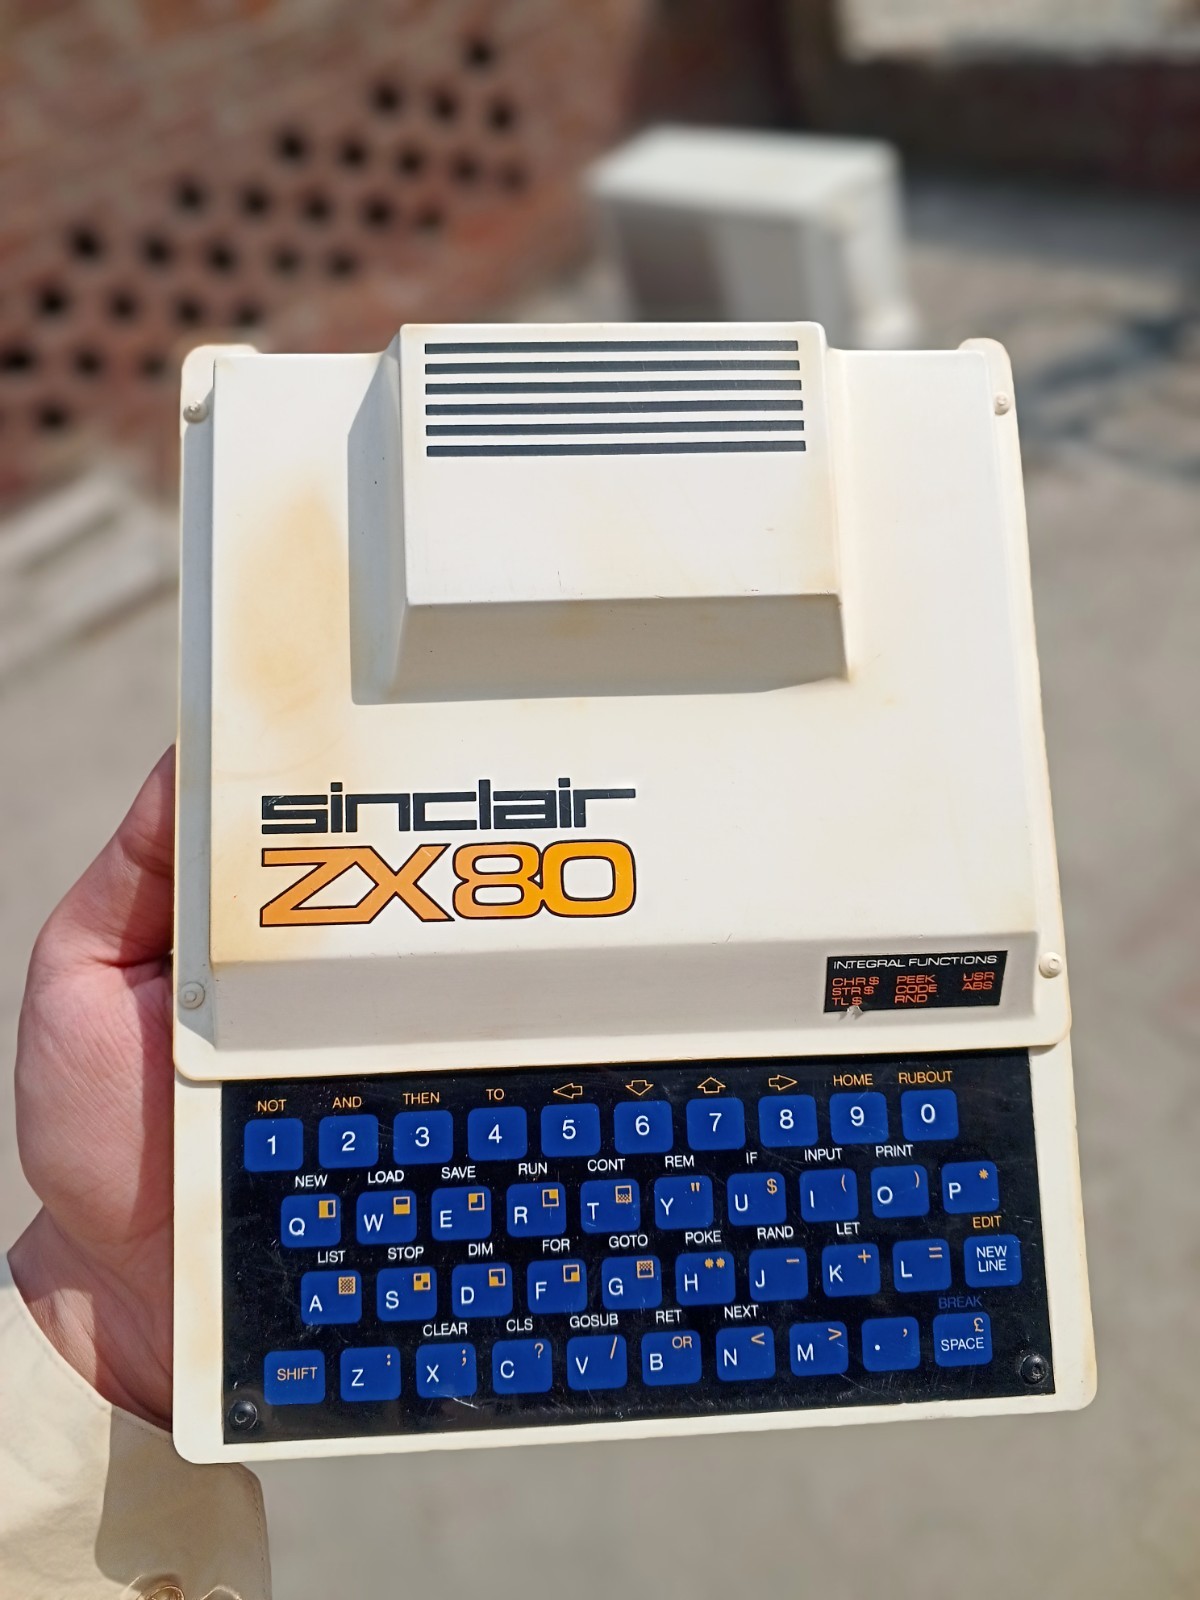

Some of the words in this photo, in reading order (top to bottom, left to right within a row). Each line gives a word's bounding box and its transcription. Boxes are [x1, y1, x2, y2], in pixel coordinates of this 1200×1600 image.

[261, 777, 636, 835] sinclair
[259, 838, 637, 928] ZX80
[833, 958, 906, 969] INTEGRAL
[908, 955, 998, 967] FUNCTIONS
[896, 974, 936, 983] PEEK
[963, 971, 995, 981] USR
[895, 984, 938, 994] CODE
[962, 981, 993, 991] ABS
[894, 994, 928, 1004] RND
[833, 1073, 874, 1087] HOME
[898, 1070, 953, 1084] RUBOUT
[332, 1095, 362, 1109] AND
[402, 1091, 440, 1105] THEN
[485, 1088, 505, 1101] TO
[257, 1098, 287, 1112] NOT
[779, 1108, 794, 1130] 8
[850, 1106, 865, 1127] 9
[920, 1103, 936, 1124] 0
[562, 1119, 577, 1140] 5
[635, 1115, 650, 1136] 6
[709, 1112, 722, 1132] 7
[341, 1130, 356, 1152] 2
[415, 1126, 430, 1148] 3
[488, 1123, 503, 1144] 4
[267, 1135, 276, 1155] 1
[875, 1144, 914, 1158] PRINT
[664, 1154, 695, 1168] REM
[745, 1151, 758, 1164] IF
[804, 1147, 843, 1162] INPUT
[441, 1165, 477, 1179] SAVE
[518, 1161, 548, 1176] RUN
[587, 1158, 626, 1172] CONT
[294, 1174, 328, 1188] NEW
[367, 1169, 405, 1184] LOAD
[876, 1186, 894, 1204] O
[948, 1182, 962, 1200] P
[660, 1197, 674, 1216] Y
[734, 1193, 749, 1212] U
[514, 1206, 528, 1225] R
[586, 1202, 600, 1220] T
[288, 1217, 306, 1236] Q
[363, 1213, 384, 1232] W
[439, 1209, 453, 1229] E
[972, 1215, 1002, 1229] EDIT
[756, 1225, 794, 1240] RAND
[835, 1221, 861, 1236] LET
[608, 1234, 649, 1249] GOTO
[684, 1230, 722, 1244] POKE
[387, 1246, 425, 1260] STOP
[468, 1242, 494, 1257] DIM
[542, 1238, 570, 1253] FOR
[976, 1245, 1007, 1258] NEW
[317, 1250, 346, 1264] LIST
[900, 1260, 913, 1278] L
[978, 1258, 1007, 1273] LINE
[755, 1269, 766, 1288] J
[829, 1264, 843, 1283] K
[608, 1277, 624, 1296] G
[684, 1273, 699, 1292] H
[460, 1286, 475, 1305] D
[535, 1281, 547, 1300] F
[309, 1294, 323, 1312] A
[385, 1290, 400, 1310] S
[939, 1296, 982, 1309] BREAK
[655, 1309, 682, 1324] RET
[724, 1304, 759, 1319] NEXT
[506, 1318, 534, 1332] CLS
[569, 1313, 619, 1329] GOSUB
[422, 1322, 468, 1337] CLEAR
[671, 1335, 693, 1349] OR
[941, 1336, 985, 1352] SPACE
[723, 1348, 738, 1367] N
[797, 1343, 814, 1362] M
[500, 1360, 515, 1379] C
[575, 1356, 589, 1375] V
[649, 1353, 664, 1371] B
[277, 1366, 318, 1381] SHIFT
[351, 1368, 365, 1387] Z
[426, 1364, 440, 1383] X
